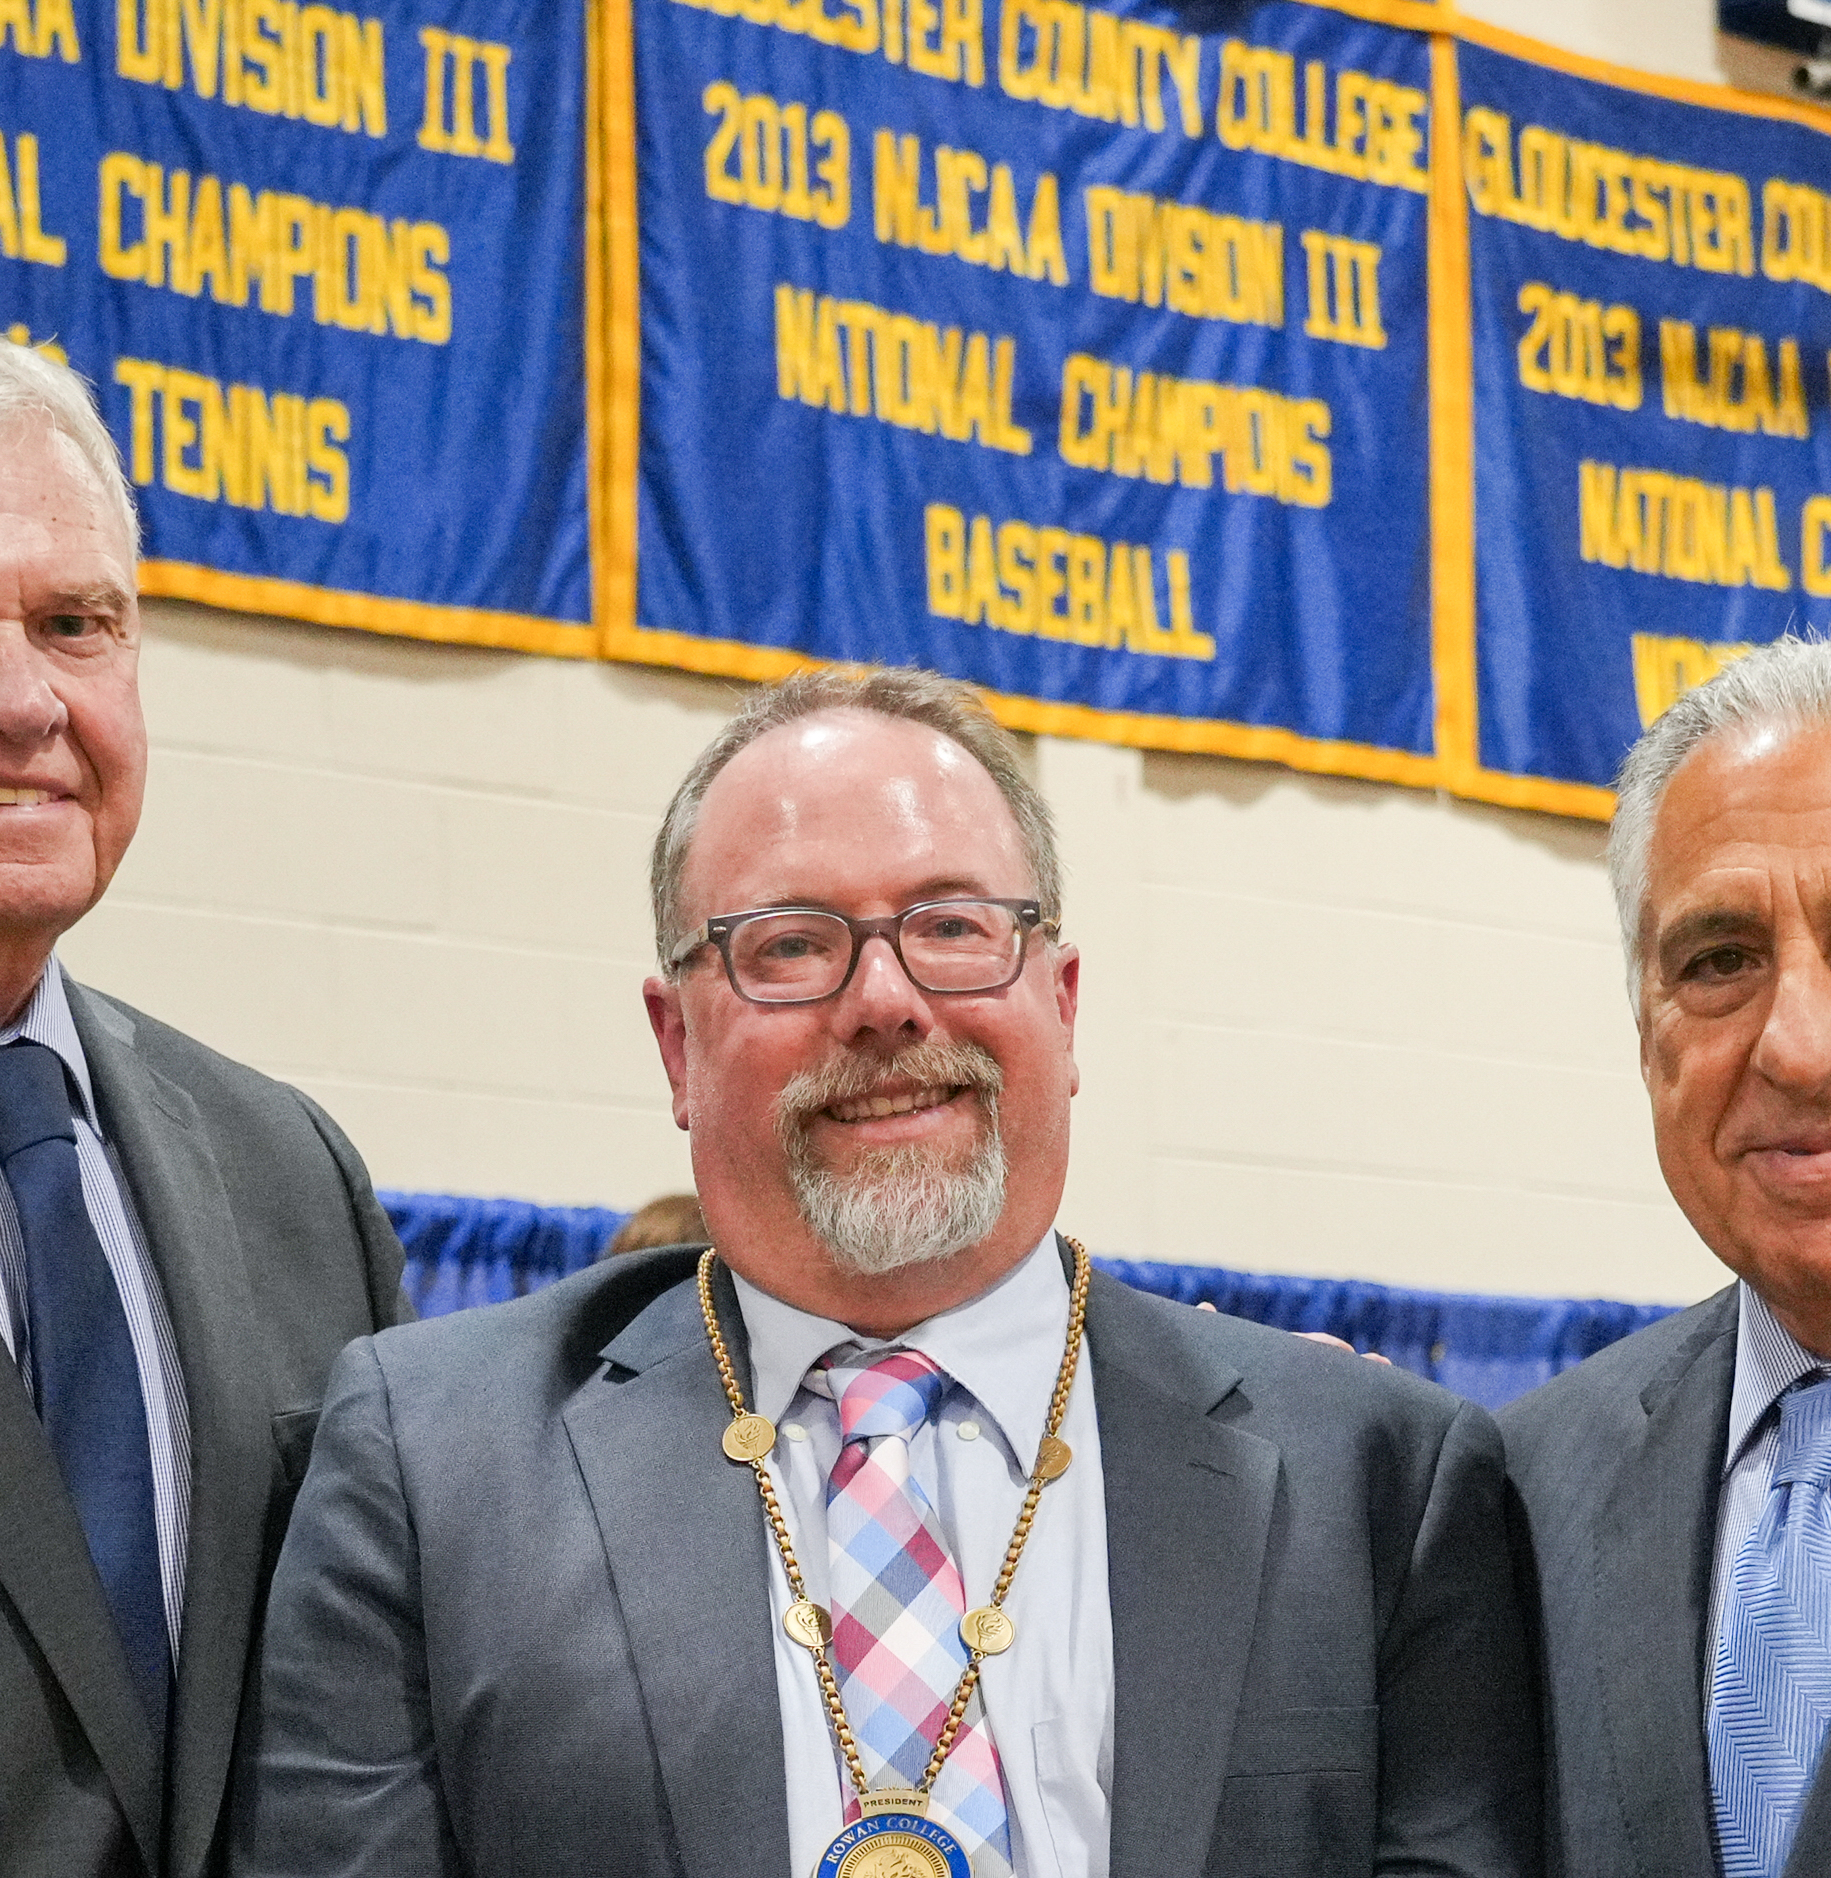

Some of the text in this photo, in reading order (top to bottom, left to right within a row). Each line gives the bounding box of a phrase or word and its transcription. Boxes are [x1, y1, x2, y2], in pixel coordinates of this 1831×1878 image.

[118, 0, 385, 137] DIVISION
[418, 26, 513, 163] III
[1000, 0, 1204, 139] COUNTY
[1219, 39, 1429, 194] COLLEGE
[99, 153, 450, 345] CHAMPIONS
[703, 83, 851, 229] 2013
[875, 128, 1068, 286] NJCAA
[1302, 229, 1387, 349] III
[1465, 107, 1754, 277] GLOUCESTER
[775, 282, 1031, 455] NATIONAL
[1517, 283, 1643, 411] 2013
[115, 358, 349, 523] TENNIS
[924, 503, 1215, 661] BASEBALL
[1578, 460, 1791, 592] NATIONAL
[826, 1816, 958, 1864] ROWAN COLLEGE
[863, 1797, 924, 1809] PRESIDENT
